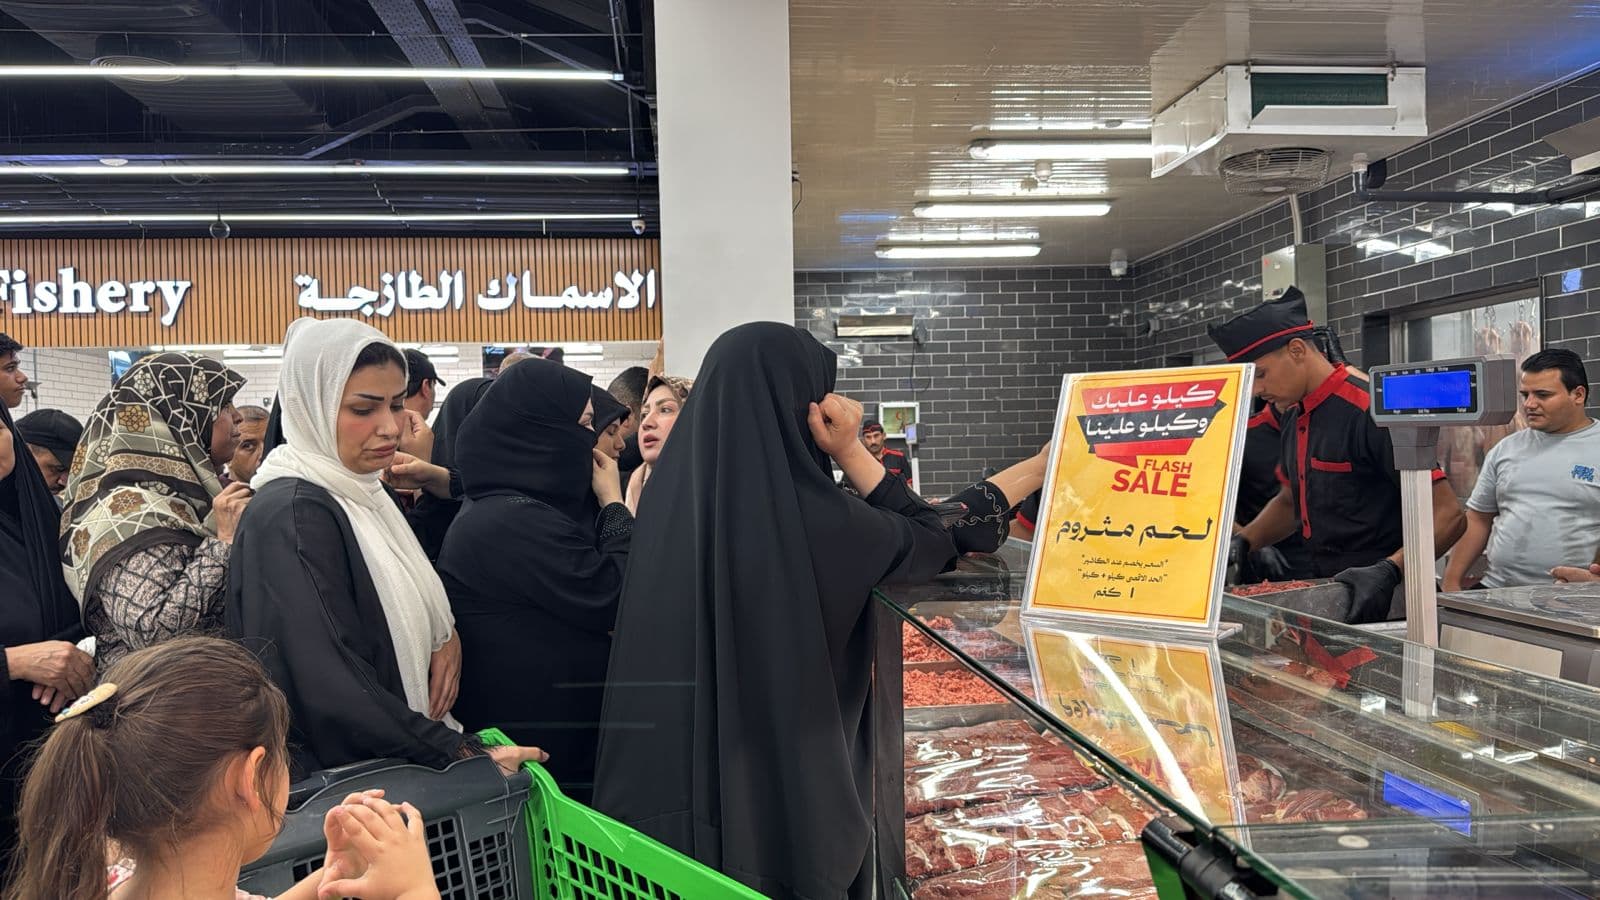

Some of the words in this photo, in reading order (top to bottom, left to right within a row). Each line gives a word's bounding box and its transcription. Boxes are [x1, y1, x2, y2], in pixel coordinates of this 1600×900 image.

[294, 270, 463, 317] الطازجة
[477, 269, 656, 310] الاسماك
[1091, 390, 1148, 413] عليك
[1152, 384, 1216, 409] كيلو
[1086, 417, 1135, 440] علينا
[1138, 412, 1208, 437] وكيلو
[1143, 459, 1192, 474] FLASH
[1111, 469, 1191, 497] SALE
[1056, 516, 1135, 544] مثروم
[1138, 516, 1213, 546] لحم
